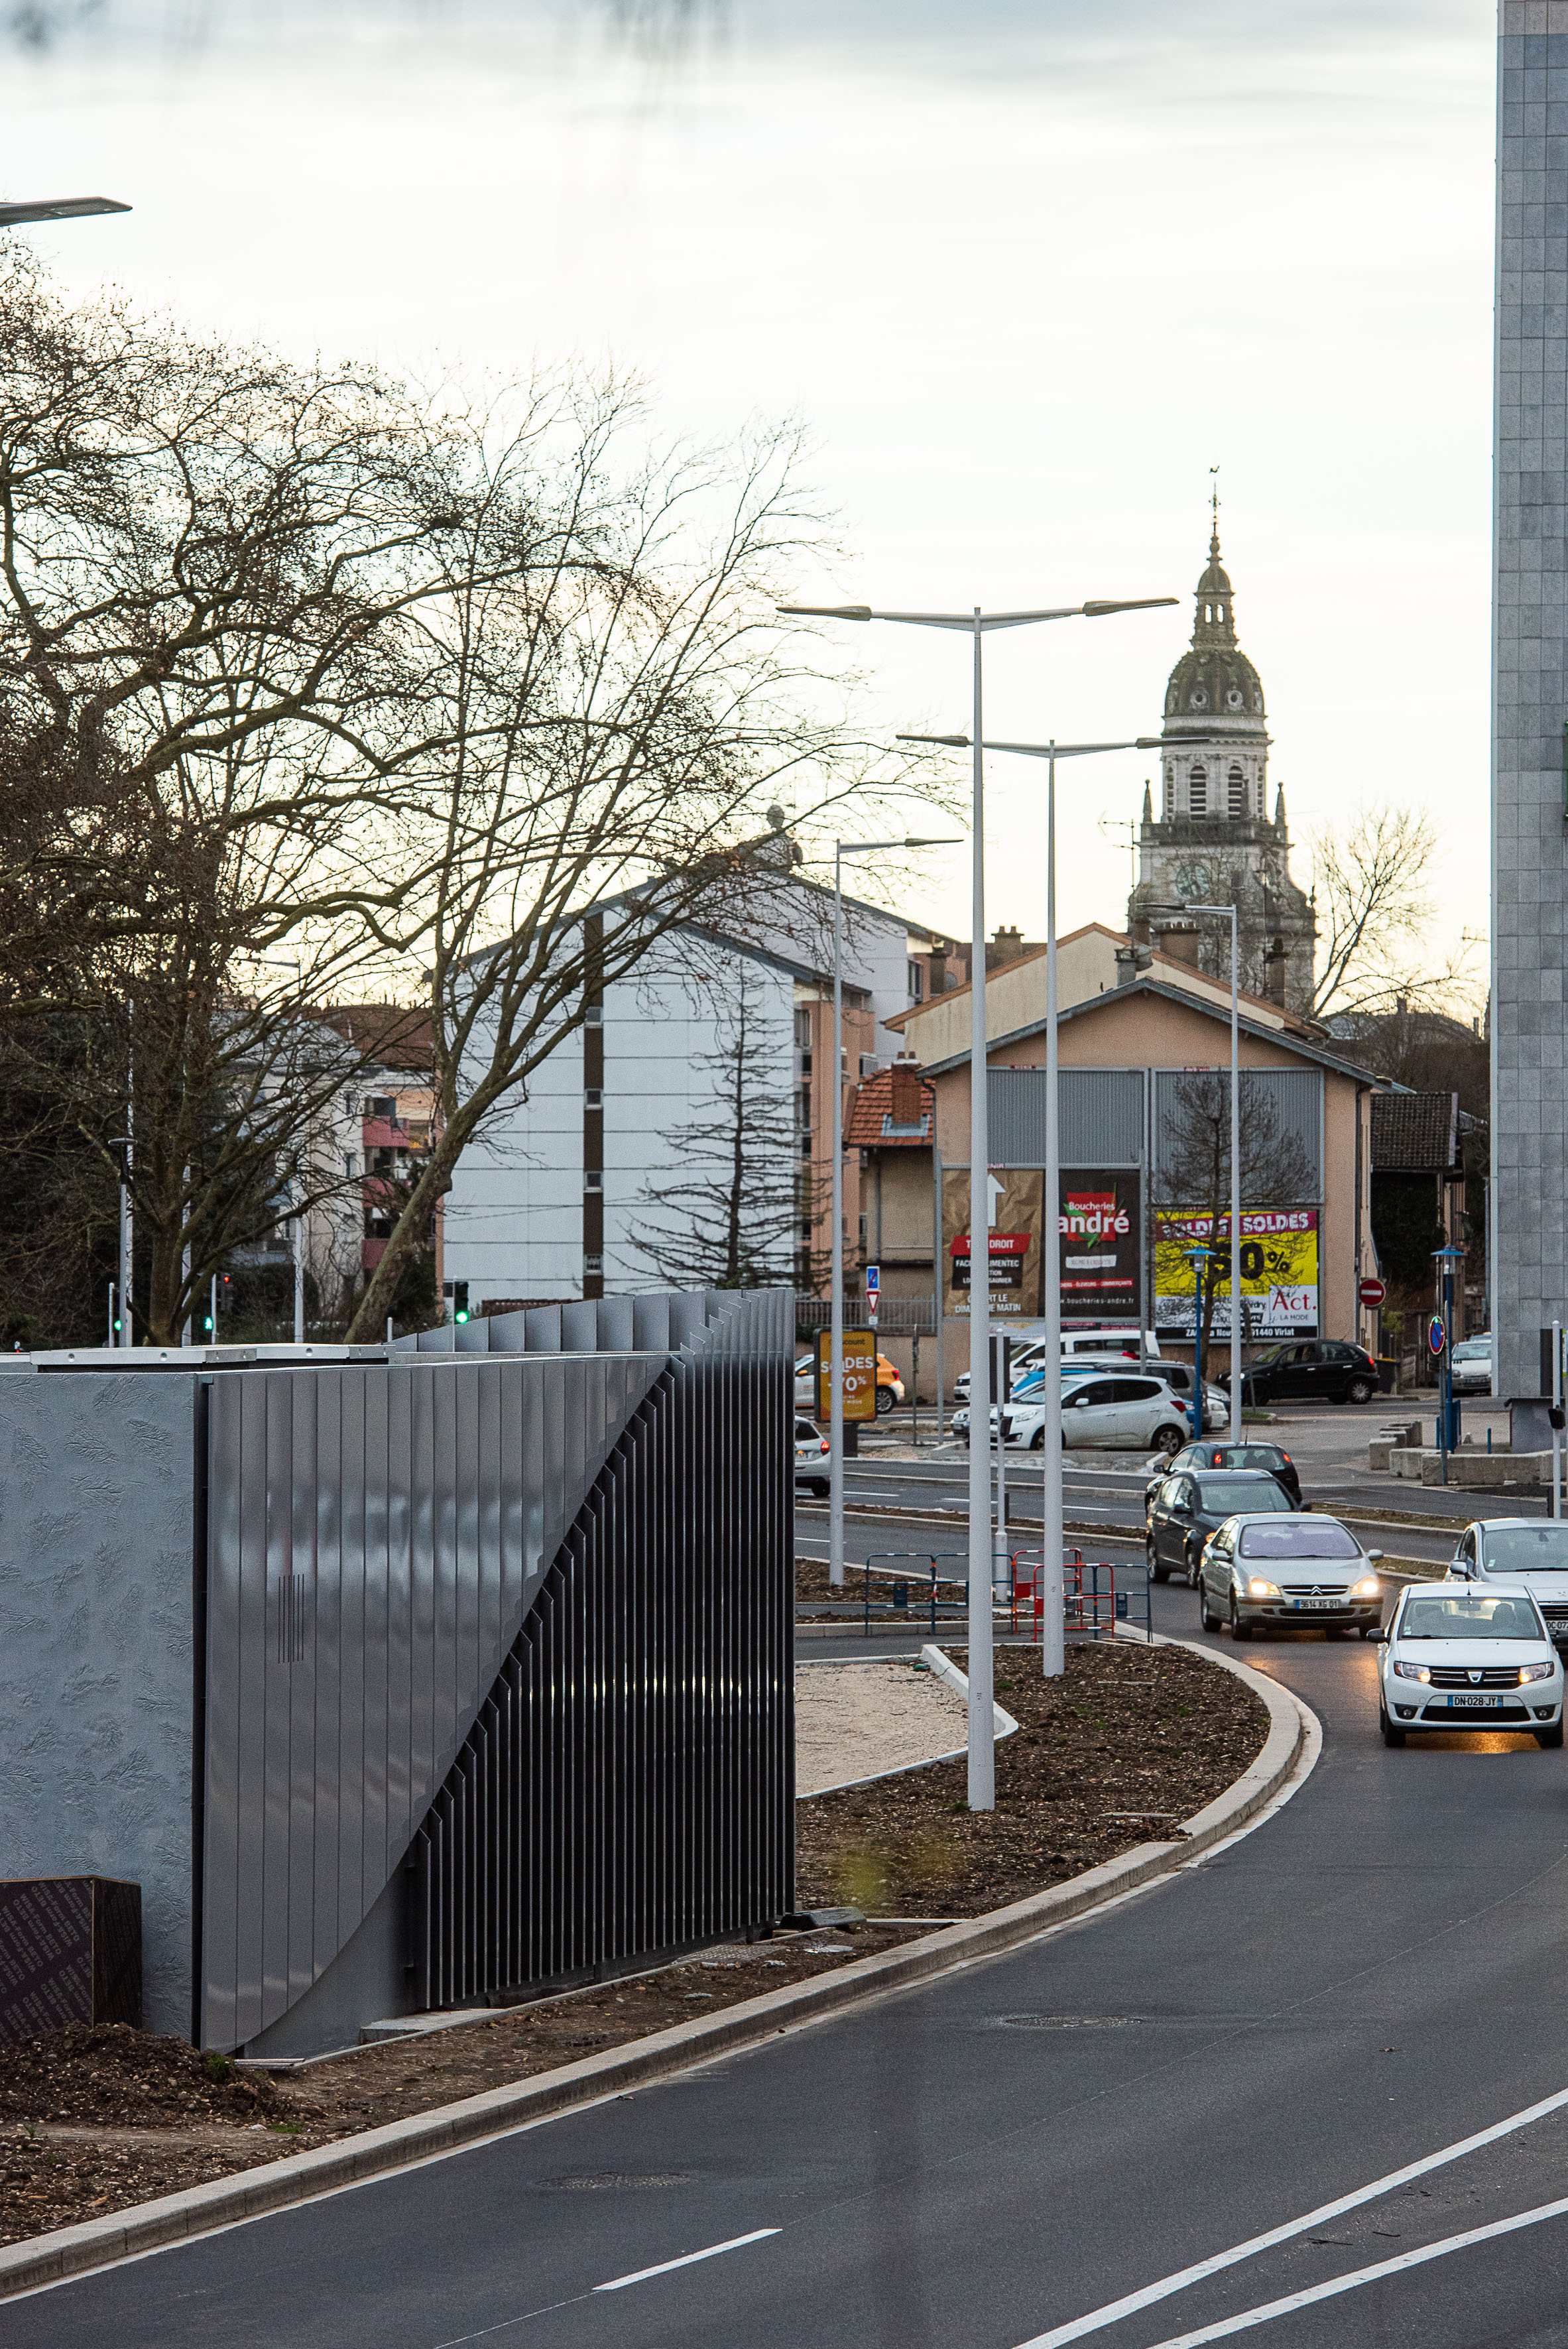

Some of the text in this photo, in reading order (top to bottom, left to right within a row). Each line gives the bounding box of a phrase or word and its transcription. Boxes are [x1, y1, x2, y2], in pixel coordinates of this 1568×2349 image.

[1069, 1201, 1115, 1211] Boucheries
[1059, 1209, 1129, 1233] andré
[1242, 1213, 1309, 1233] SOLDES
[989, 1240, 1014, 1249] DROIT
[998, 1294, 1008, 1302] LE
[1272, 1290, 1317, 1311] Act.
[996, 1303, 1021, 1312] MATIN
[1454, 1697, 1496, 1706] DN-028-JY
